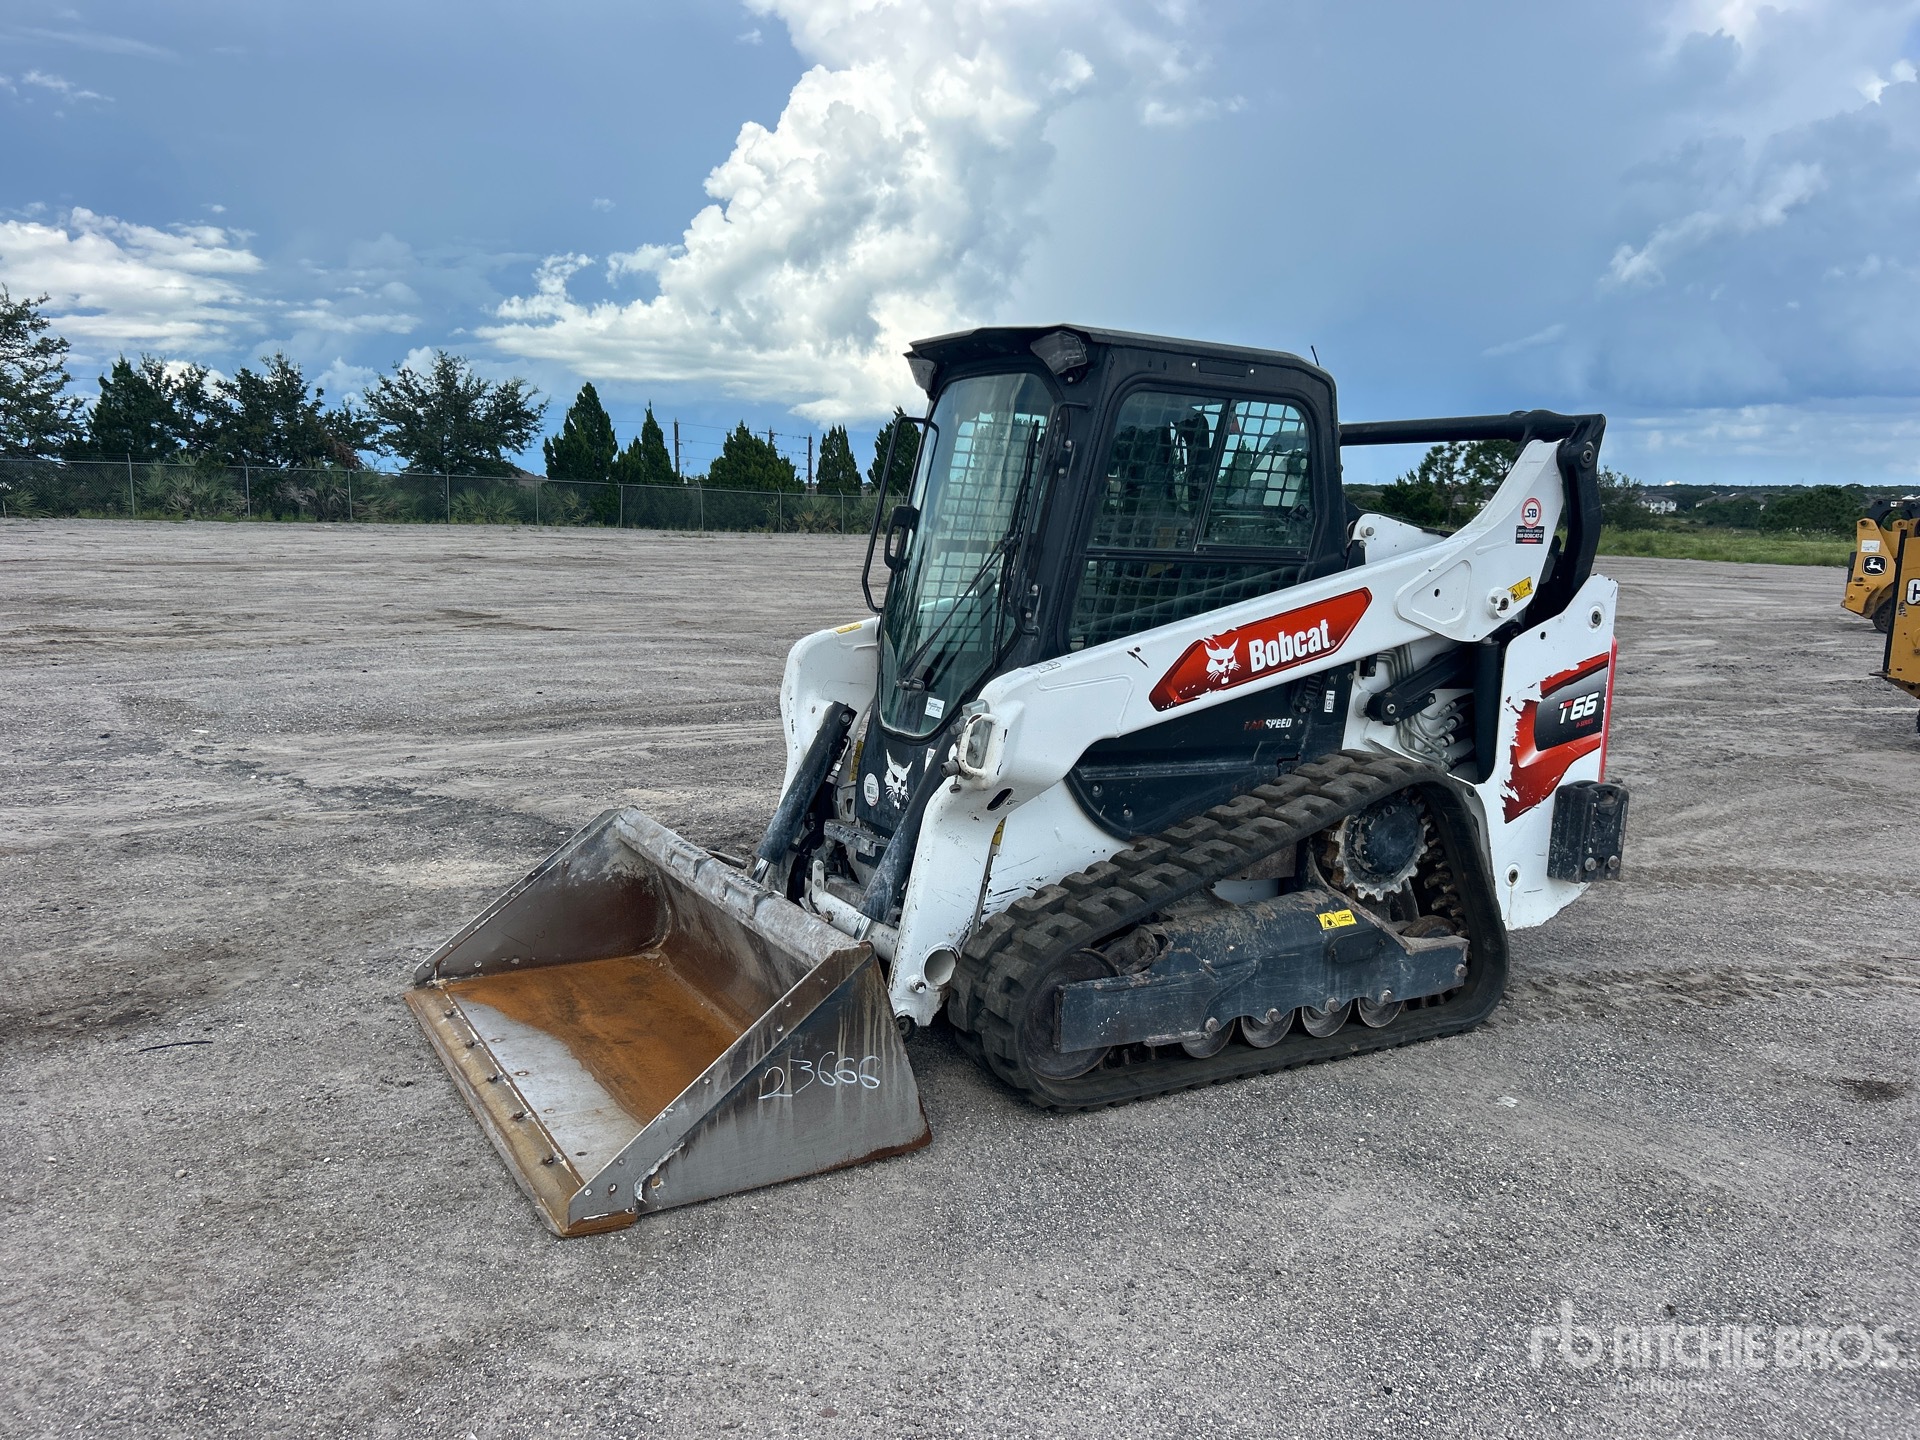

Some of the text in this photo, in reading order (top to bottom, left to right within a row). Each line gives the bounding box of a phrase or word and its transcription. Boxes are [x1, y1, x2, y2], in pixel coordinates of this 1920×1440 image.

[1248, 618, 1331, 673] Bobcat
[1558, 692, 1600, 725] T66
[758, 1051, 880, 1099] 23666
